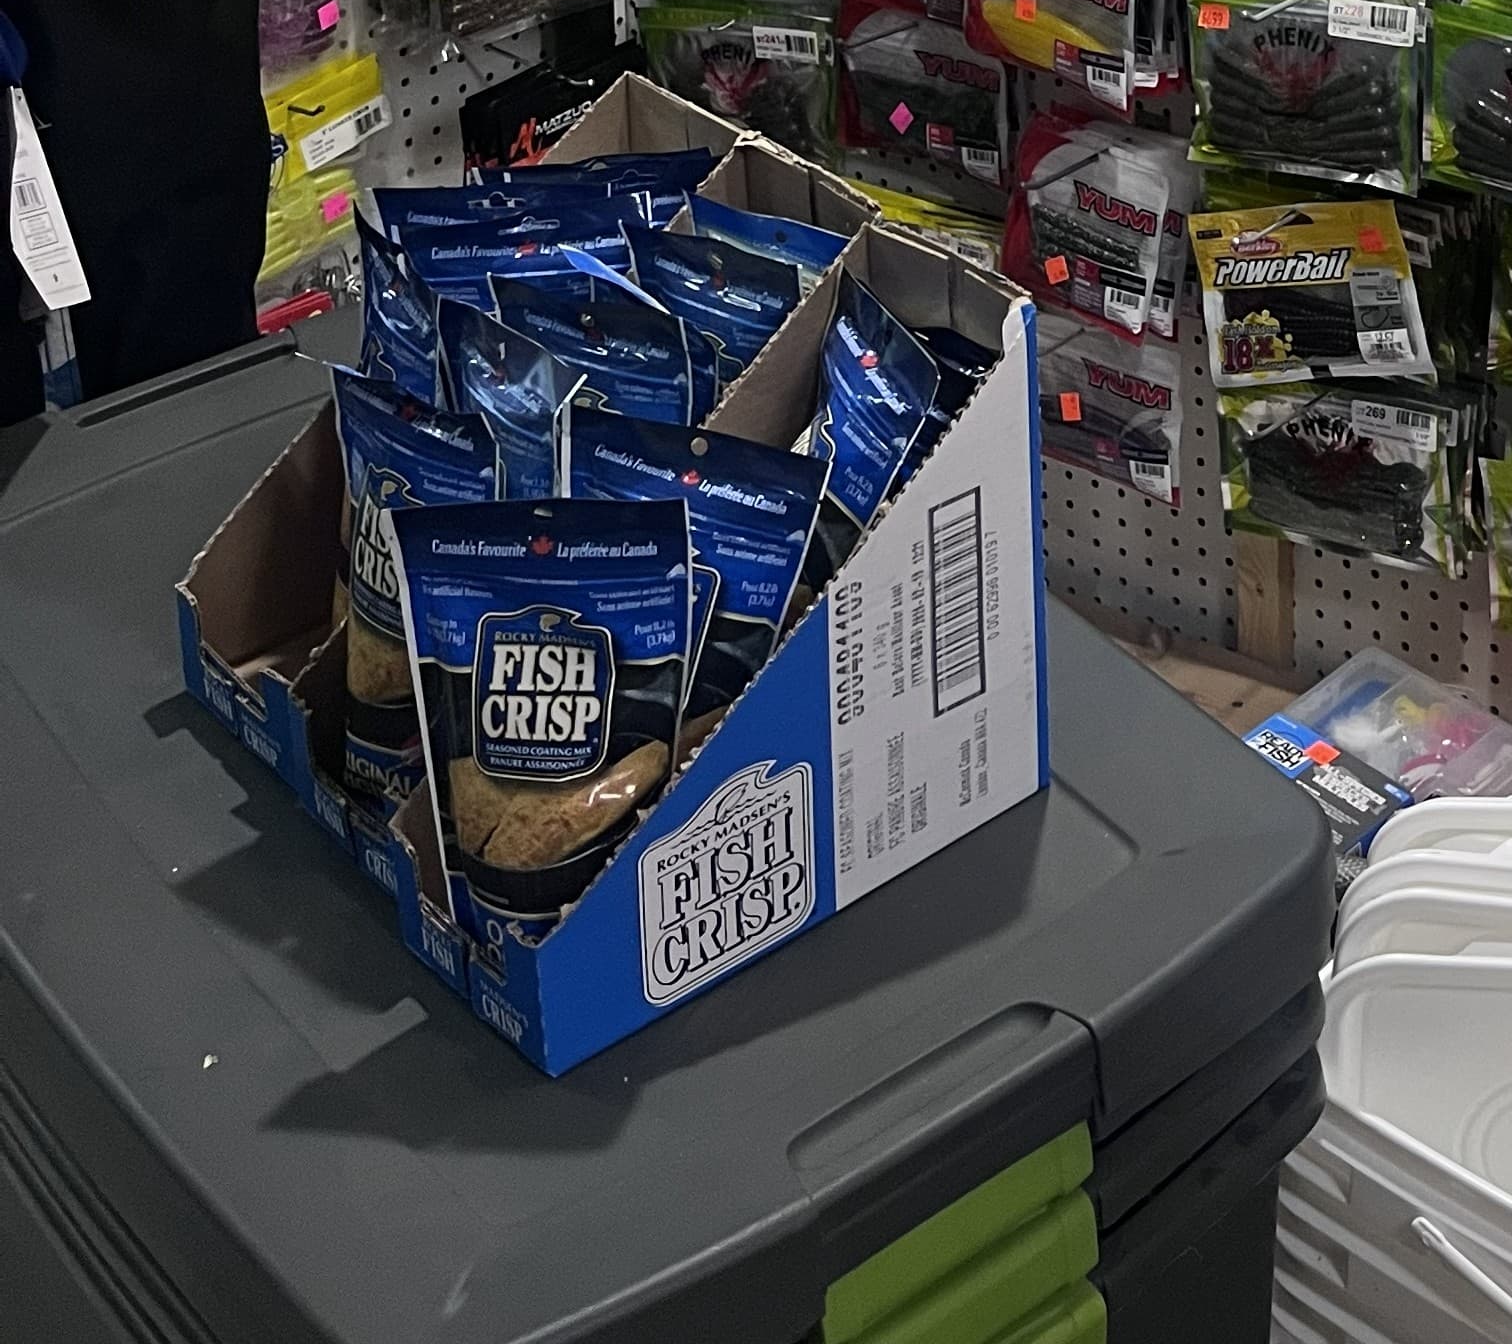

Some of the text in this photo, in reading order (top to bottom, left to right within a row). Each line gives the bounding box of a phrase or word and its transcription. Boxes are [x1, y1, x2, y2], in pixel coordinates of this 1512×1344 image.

[1253, 26, 1332, 60] PHENIX
[535, 102, 591, 135] MATZUO
[1075, 180, 1156, 234] YUM
[1214, 249, 1351, 285] PowerBait
[432, 540, 526, 556] Canada's Favourite
[489, 644, 596, 692] FISH
[482, 695, 600, 742] CRISP
[530, 746, 572, 756] COATING
[574, 746, 592, 754] MIX
[1259, 729, 1306, 756] READY
[1259, 741, 1297, 768] FISH
[657, 791, 790, 873] ROCKY MADSEN'S
[658, 807, 794, 930] FISH
